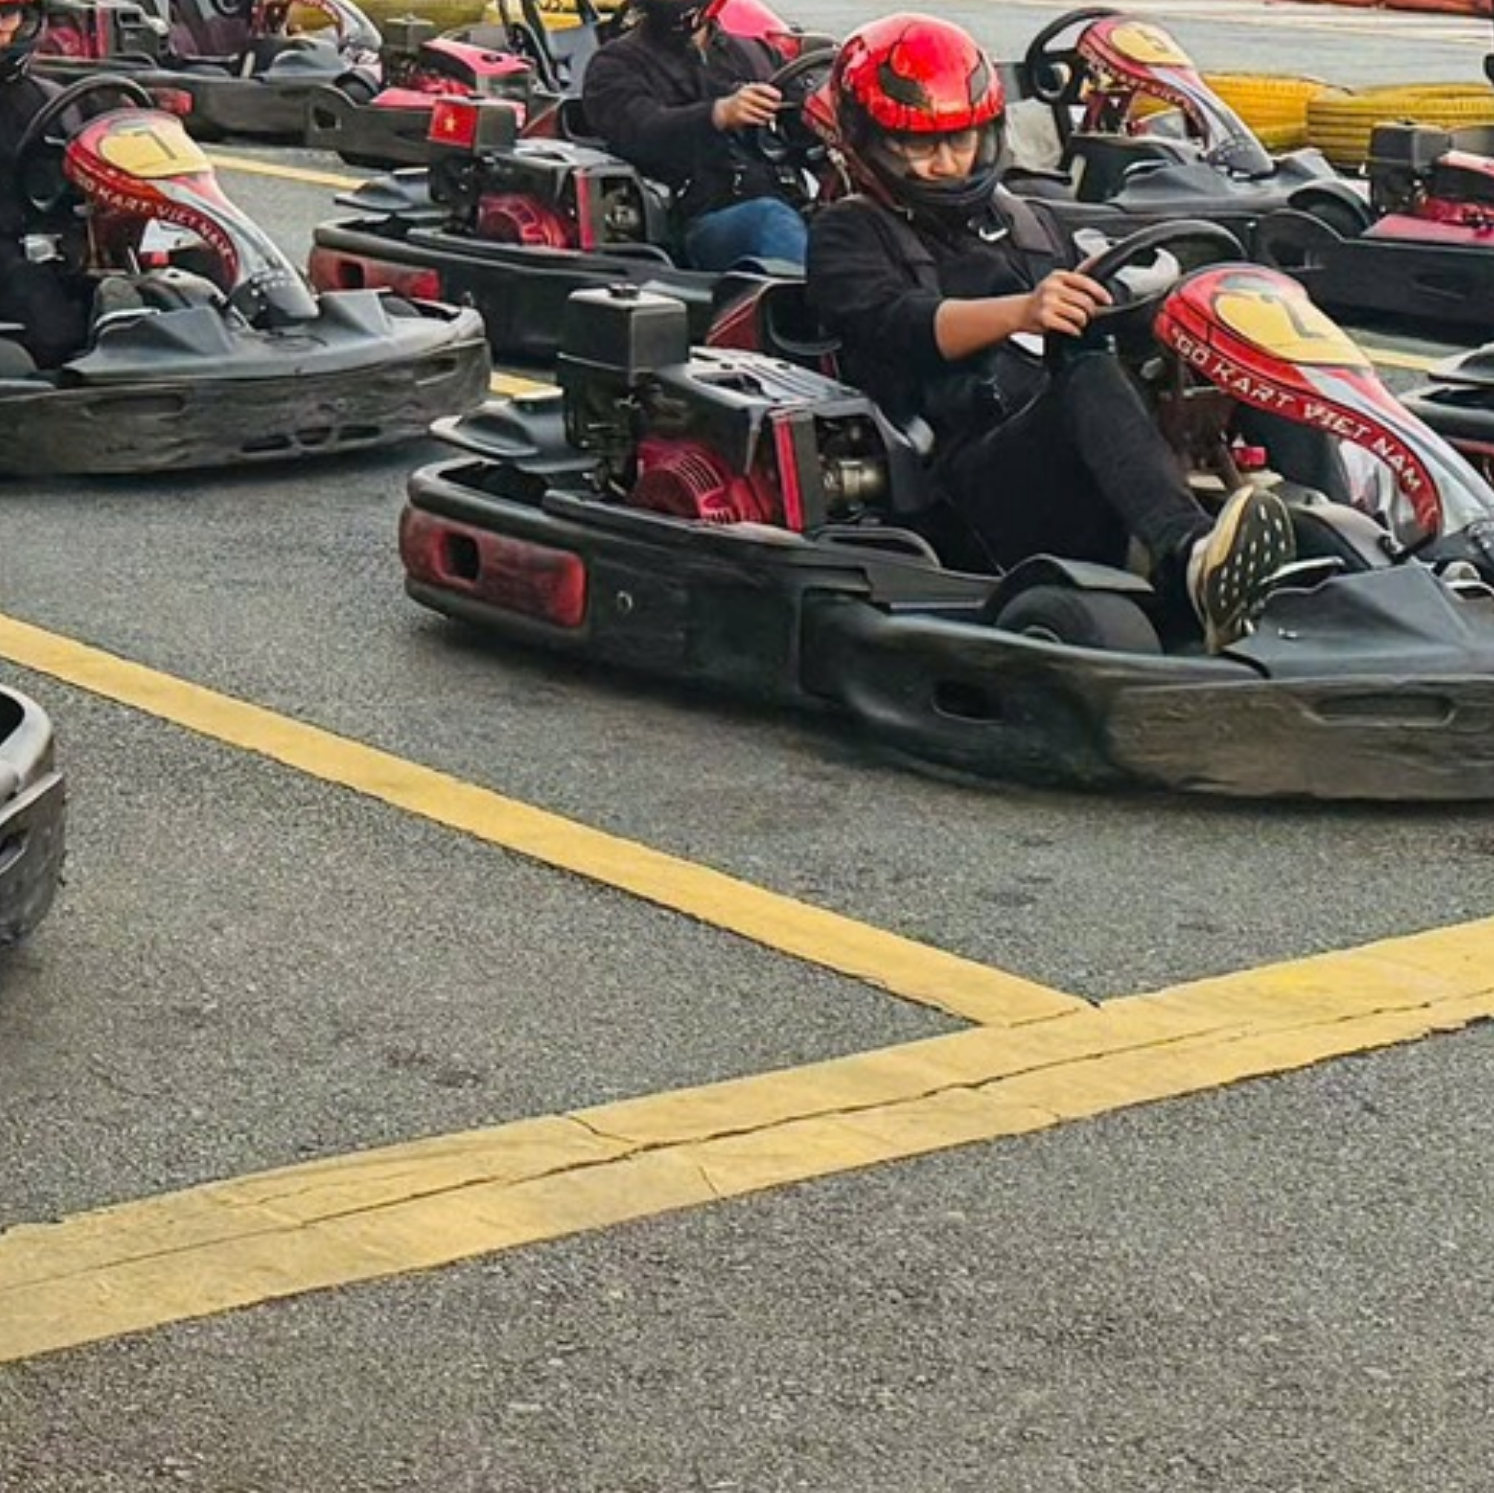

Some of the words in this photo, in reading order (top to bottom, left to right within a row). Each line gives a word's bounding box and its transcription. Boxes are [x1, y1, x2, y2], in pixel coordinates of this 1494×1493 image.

[1211, 358, 1296, 408] KART
[1303, 401, 1371, 439] VIET
[1371, 436, 1423, 491] NAM
